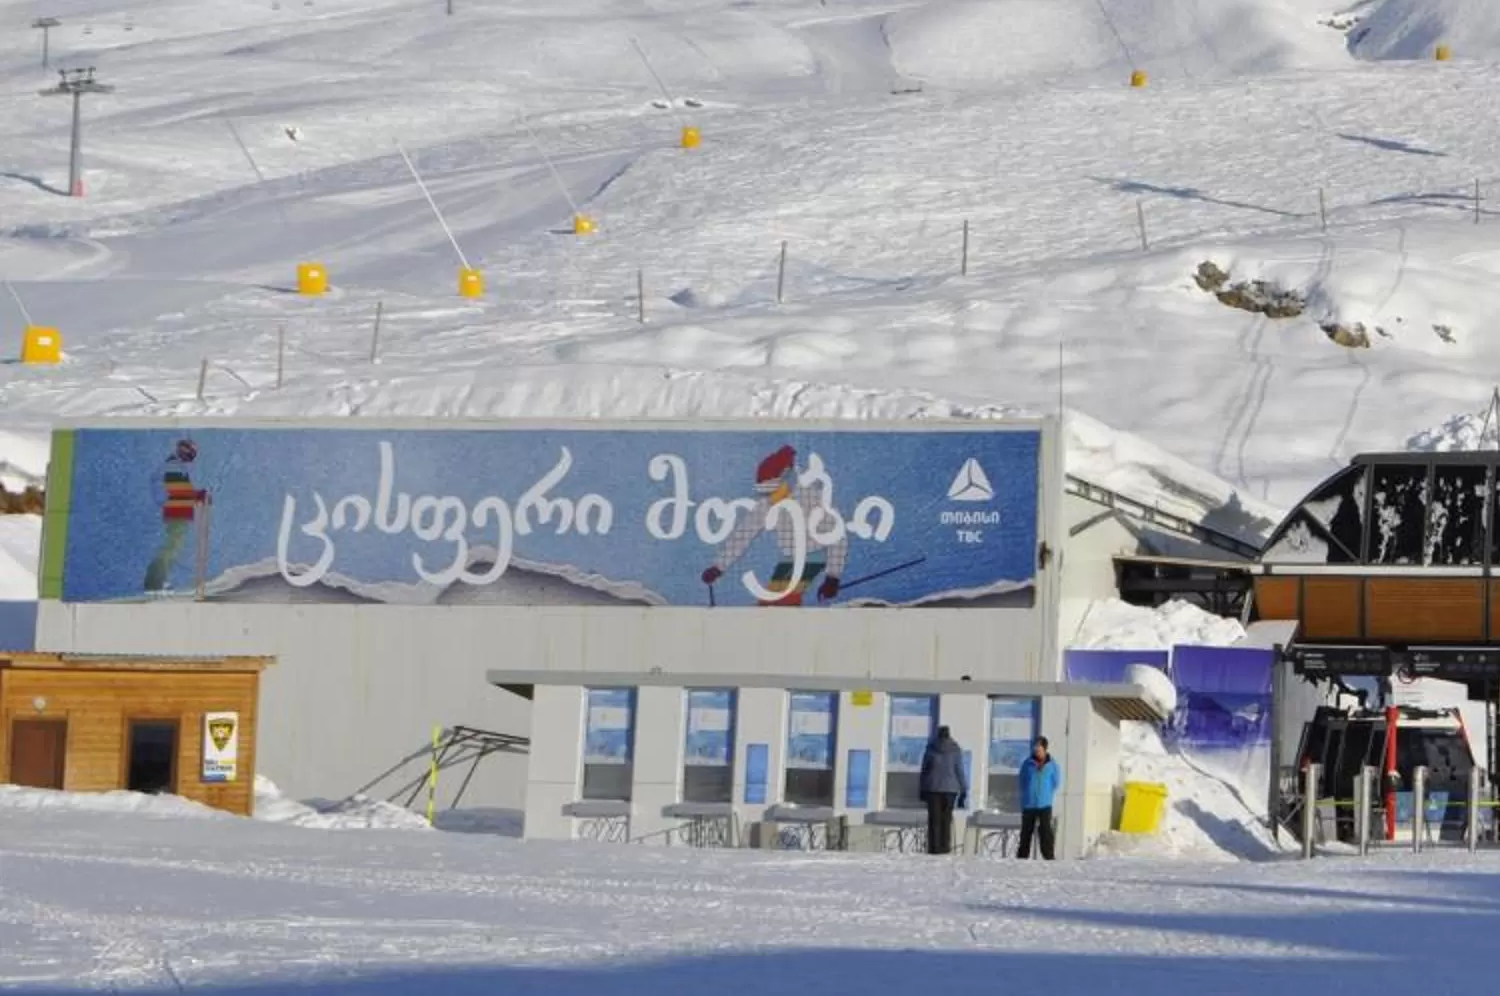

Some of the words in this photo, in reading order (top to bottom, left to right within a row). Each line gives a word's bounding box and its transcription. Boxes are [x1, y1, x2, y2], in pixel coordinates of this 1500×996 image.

[277, 440, 614, 587] ცისფერი
[645, 452, 896, 602] მთები
[941, 510, 1000, 525] თიბისი
[956, 529, 984, 543] TBC
